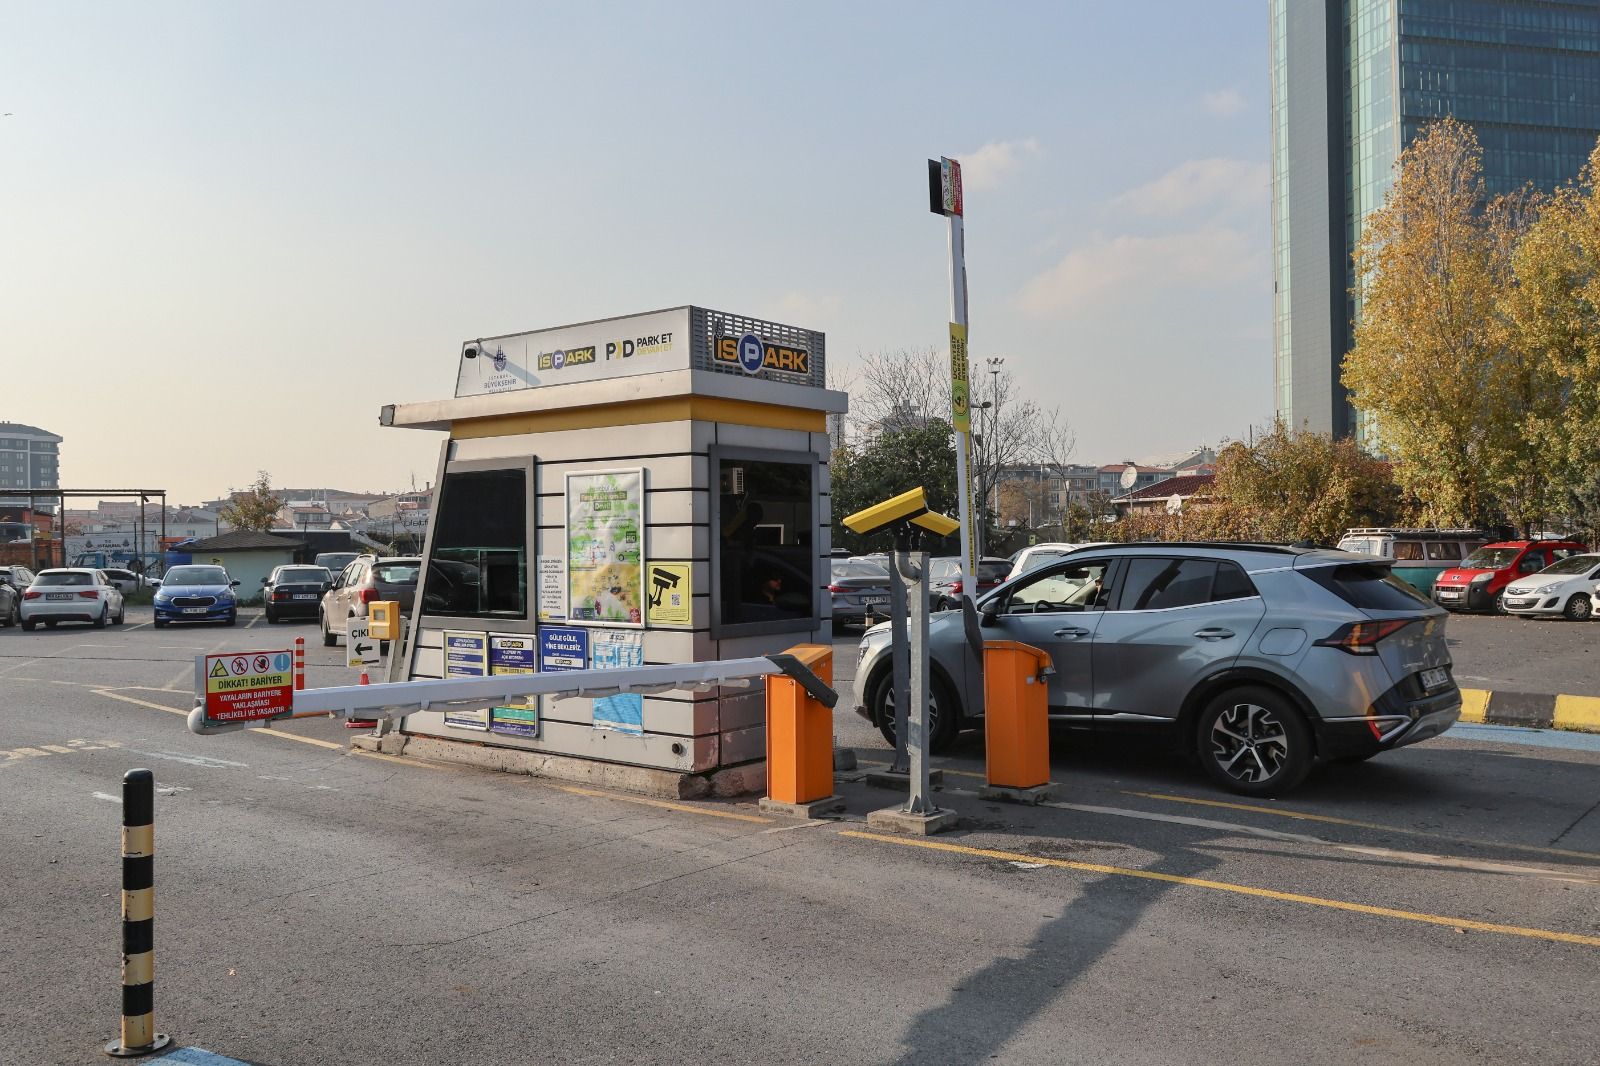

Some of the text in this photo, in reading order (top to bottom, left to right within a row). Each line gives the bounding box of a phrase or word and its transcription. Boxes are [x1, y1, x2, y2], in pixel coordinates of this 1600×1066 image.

[637, 333, 672, 347] PARK ET
[351, 629, 369, 639] ÇIKI
[218, 676, 282, 689] DİKKAT! BARİYER
[219, 692, 252, 702] YAYALARIN
[232, 699, 270, 709] YAKLAŞMASI
[216, 711, 247, 720] TEHLİKELİ
[256, 706, 285, 715] YASAKTIR
